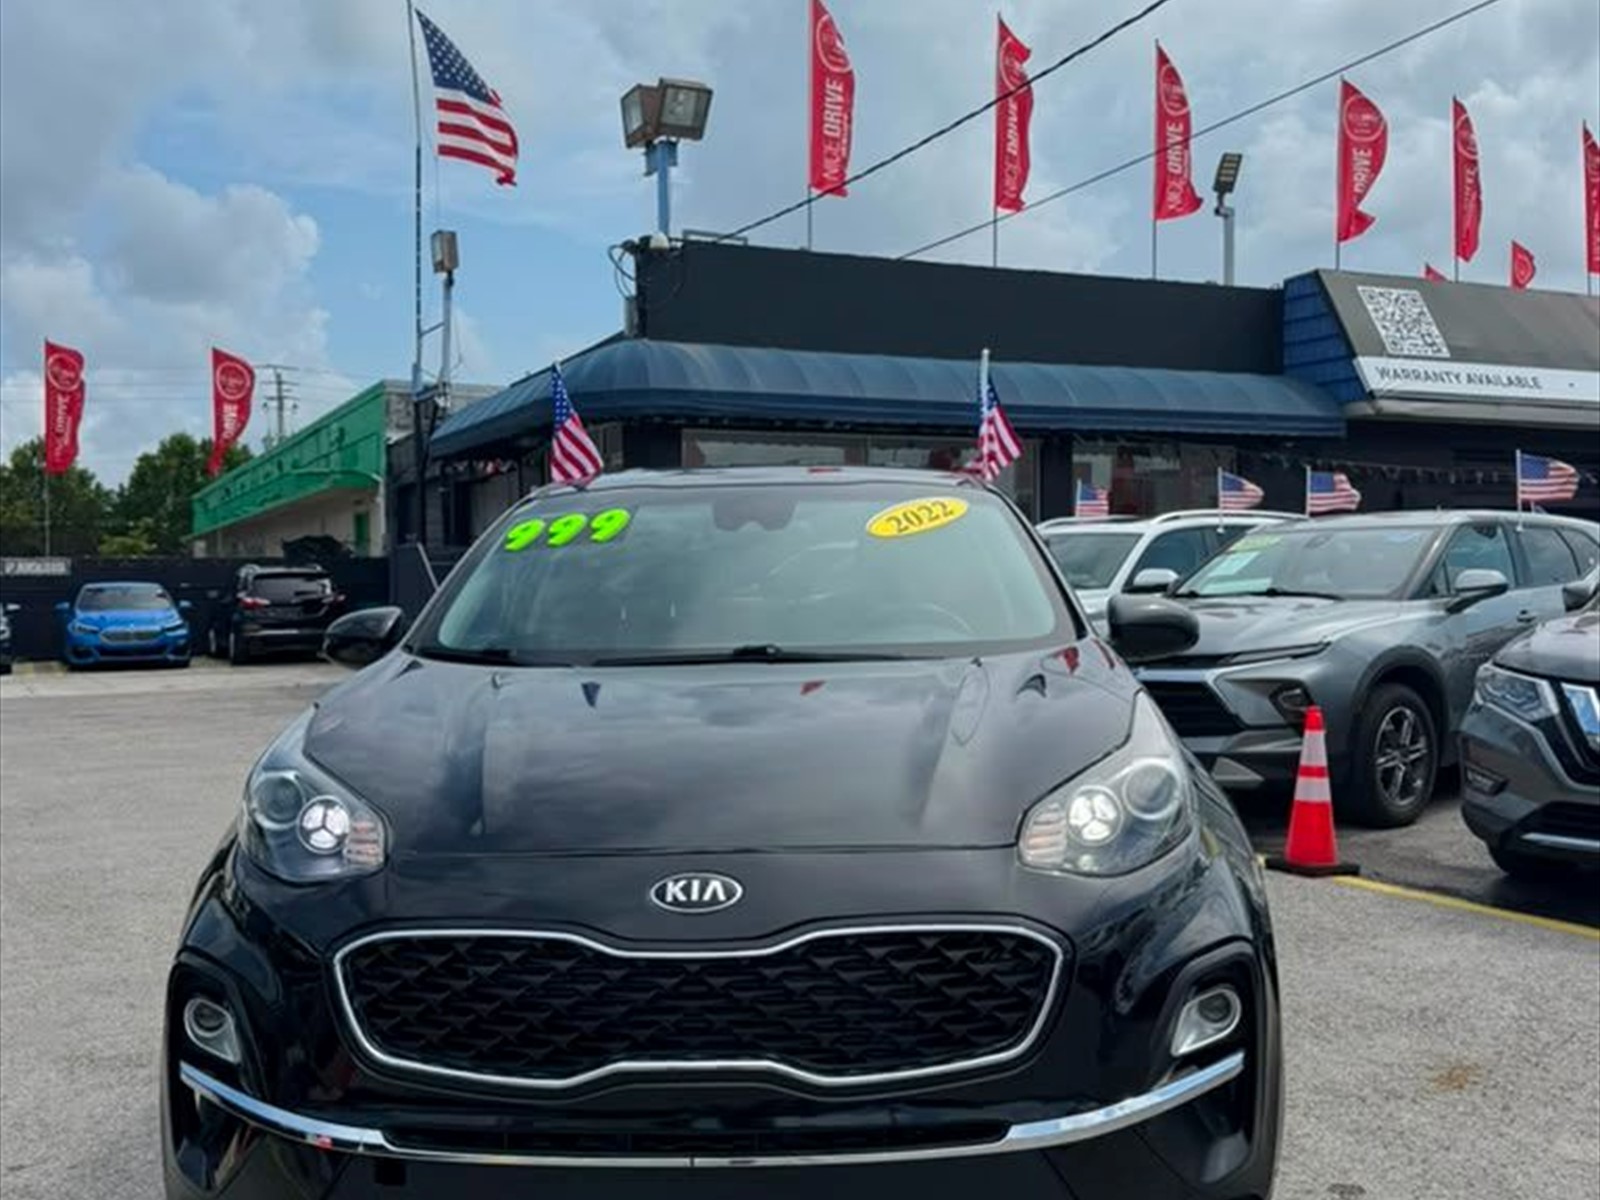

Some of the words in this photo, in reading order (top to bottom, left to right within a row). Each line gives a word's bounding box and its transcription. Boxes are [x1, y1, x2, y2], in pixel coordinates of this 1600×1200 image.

[823, 77, 844, 138] DRIVE
[1165, 120, 1183, 174] DRIVE
[1352, 146, 1373, 194] DRIVE
[1375, 366, 1462, 384] WARRANTY
[1466, 373, 1543, 390] AVAILABLE
[504, 508, 631, 552] 999
[885, 500, 954, 534] 2022
[665, 878, 727, 903] KIA
